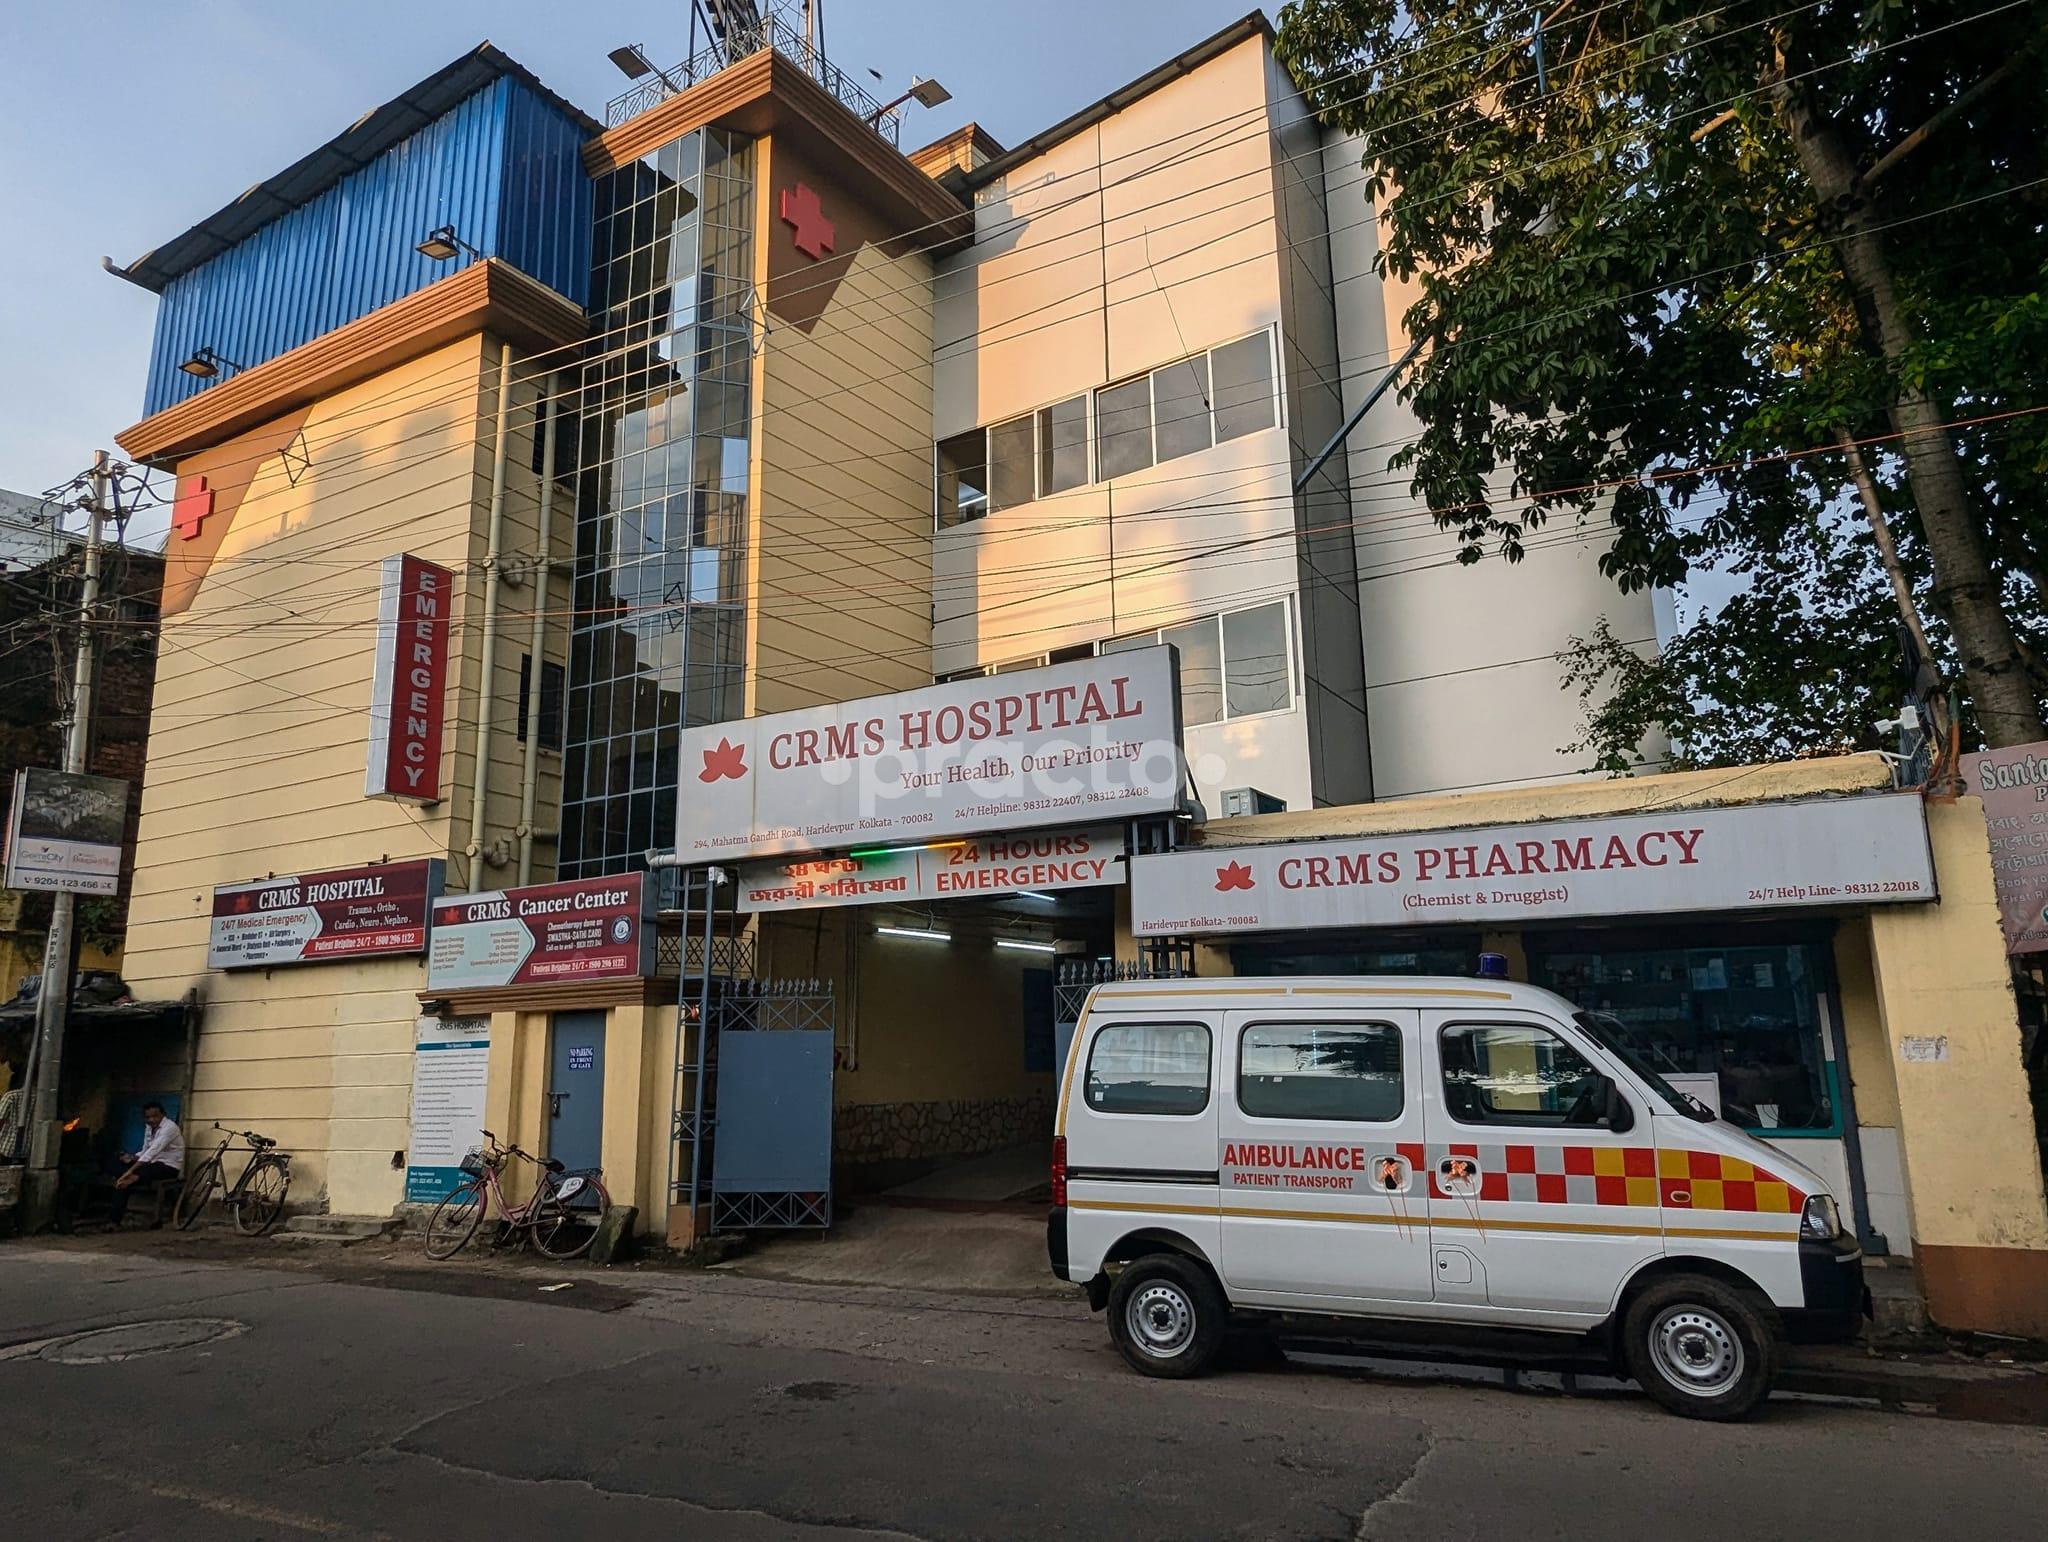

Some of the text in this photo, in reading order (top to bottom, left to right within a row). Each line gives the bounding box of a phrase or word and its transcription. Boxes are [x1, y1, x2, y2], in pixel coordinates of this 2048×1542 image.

[404, 571, 436, 787] EMERGENCY
[769, 677, 1143, 770] CRMS HOSPITAL
[901, 740, 1144, 789] Your Health, Our Priority
[955, 786, 1149, 818] 24/7 Helpline: 98312 22407, 98312 22408
[711, 835, 748, 848] Mahatma
[750, 830, 779, 843] Gandhi
[781, 827, 804, 839] Road,
[806, 822, 855, 836] Haridevpur
[859, 817, 892, 830] Kolkata
[902, 812, 933, 824] 700082
[949, 834, 1090, 866] 24 HOURS
[1278, 829, 1704, 889] CRMS PHARMACY
[34, 877, 58, 886] 9204
[936, 858, 1107, 892] EMERGENCY
[1749, 887, 1773, 900] 24/7
[1776, 885, 1806, 899] Help
[1845, 882, 1879, 894] 98312
[1883, 880, 1920, 892] 22018
[259, 877, 385, 909] CRMS HOSPITAL
[467, 890, 629, 921] CRMS Cancer Center
[1403, 885, 1569, 911] (Chemist & Druggist)
[237, 917, 264, 929] Medical
[266, 913, 308, 926] Emergency
[1142, 918, 1188, 931] Haridevpur
[1228, 915, 1258, 925] 700082
[454, 1020, 486, 1030] HOSPITAL
[1223, 1144, 1365, 1171] AMBULANCE
[1233, 1174, 1354, 1190] PATIENT TRANSPORT
